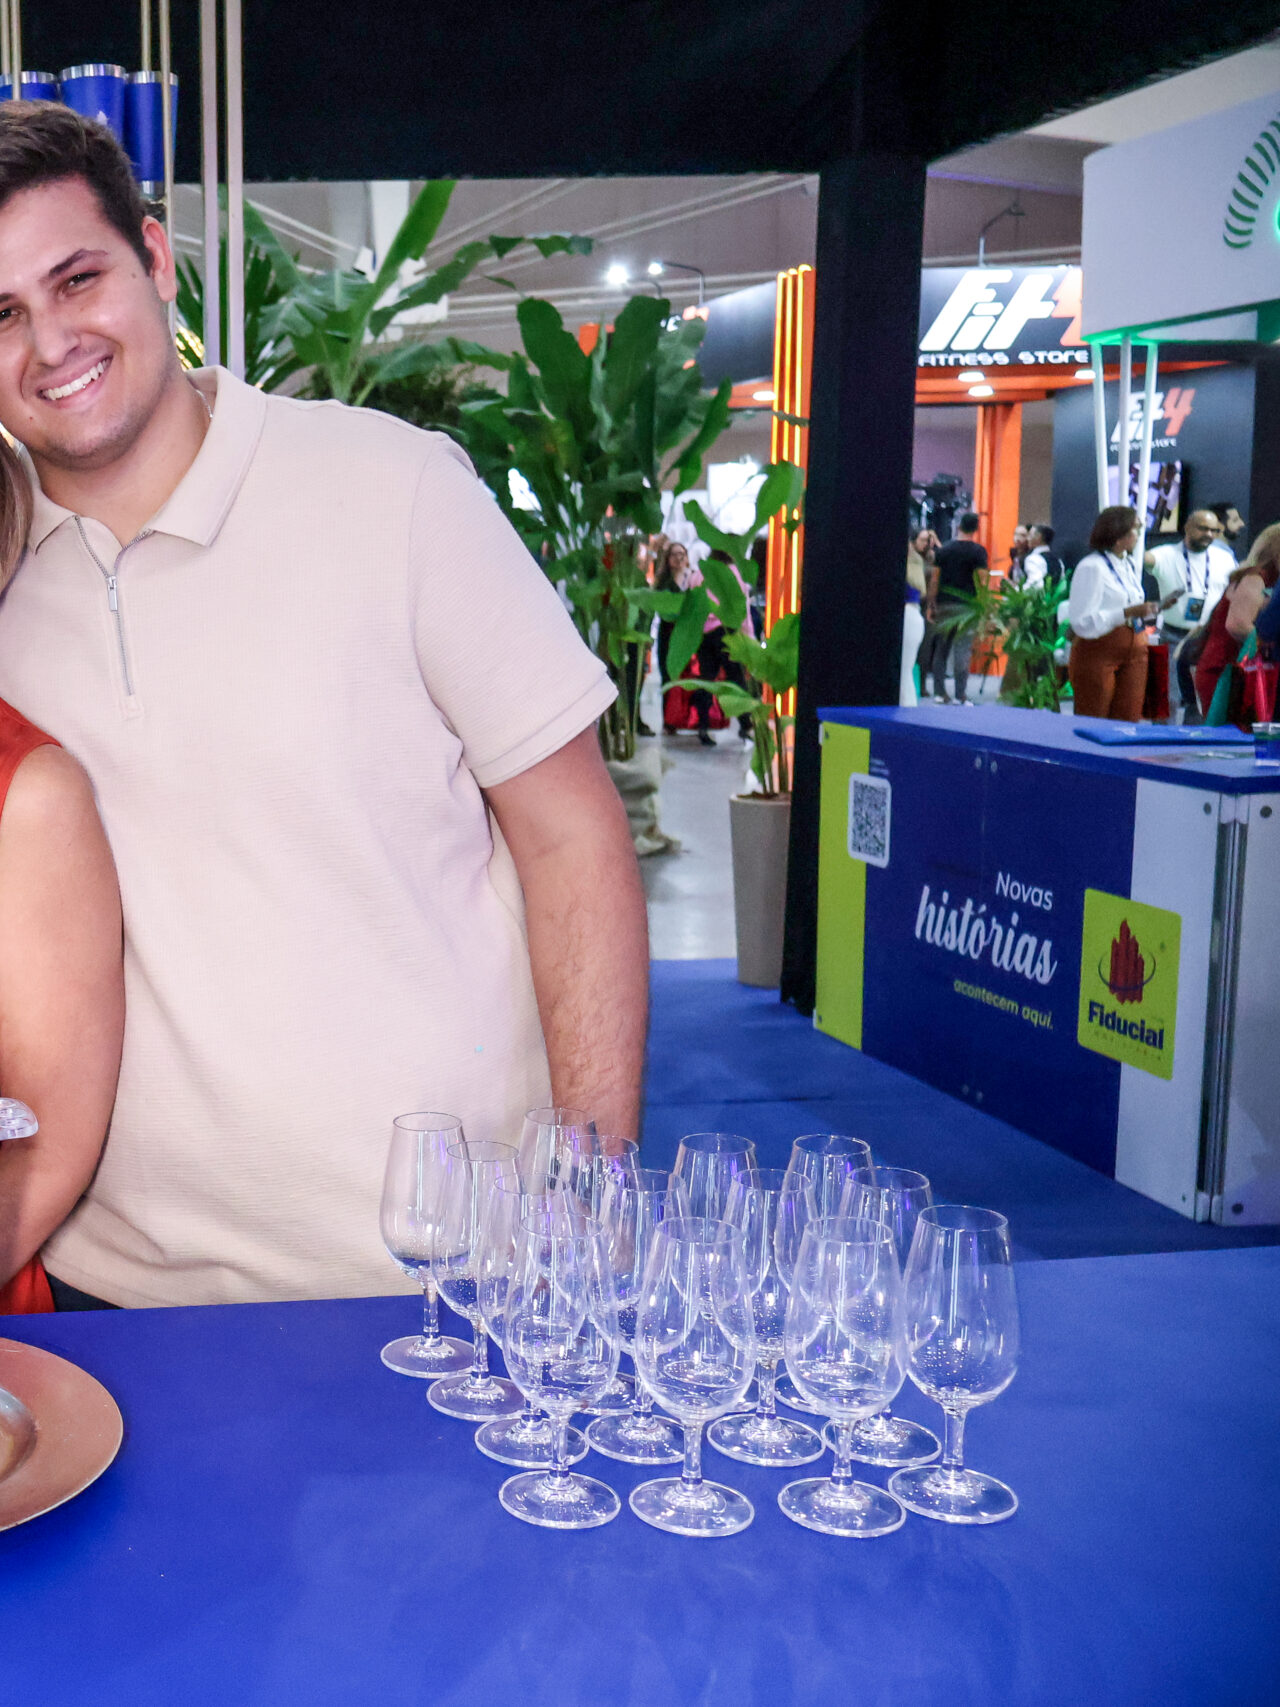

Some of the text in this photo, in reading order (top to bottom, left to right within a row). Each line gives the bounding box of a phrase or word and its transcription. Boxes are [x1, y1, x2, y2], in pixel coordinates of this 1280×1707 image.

[918, 352, 1009, 367] FITNESS
[995, 870, 1054, 912] Novas
[915, 884, 1058, 986] histórias
[953, 979, 1054, 1030] acontecem aqui.
[1087, 999, 1165, 1051] Fiducial
